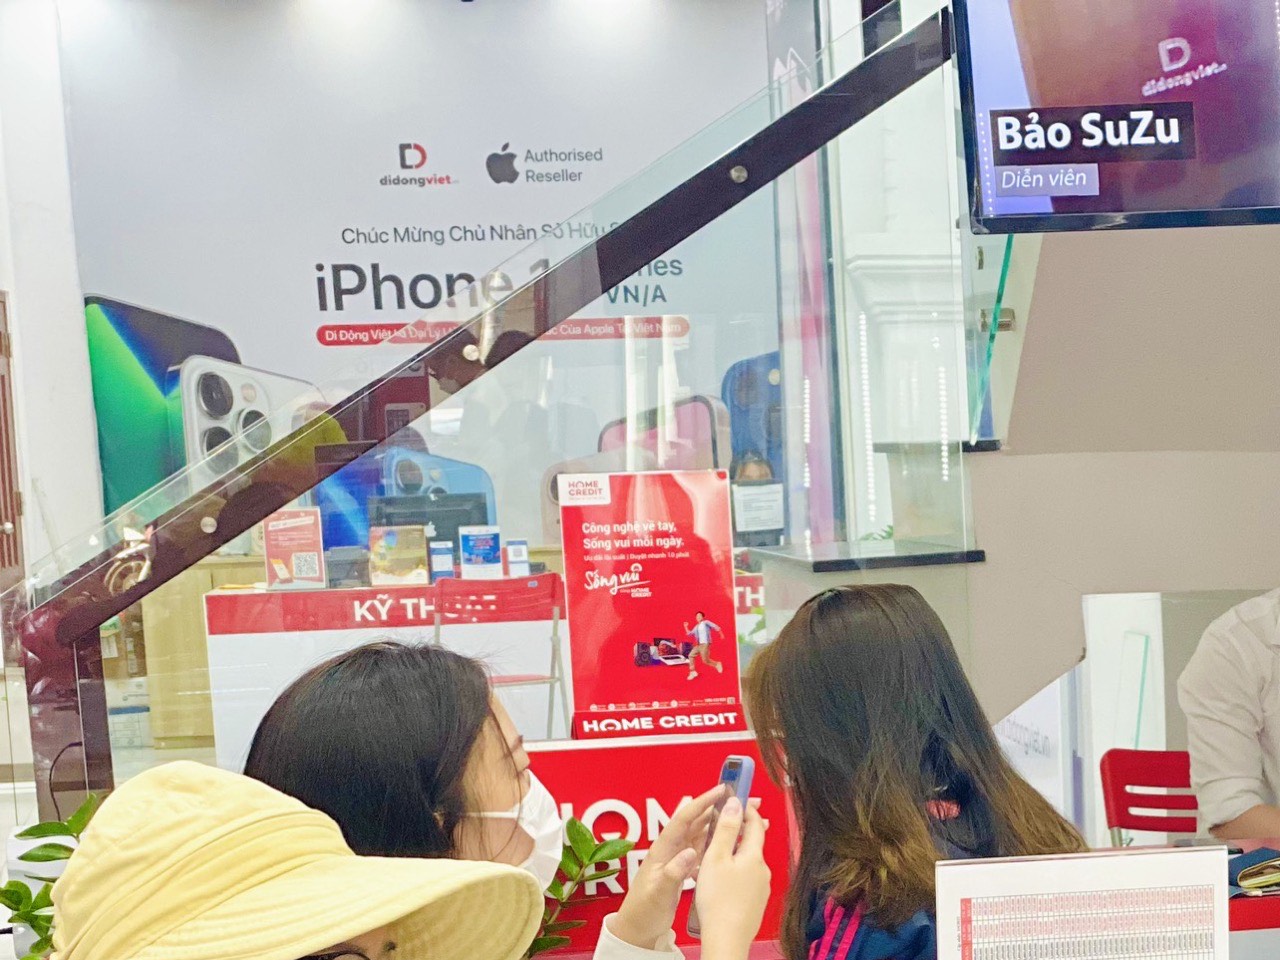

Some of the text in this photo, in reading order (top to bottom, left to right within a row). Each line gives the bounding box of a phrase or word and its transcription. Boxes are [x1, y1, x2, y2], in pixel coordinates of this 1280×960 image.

[998, 110, 1181, 150] Bảo SuZu
[524, 148, 603, 164] Authorised
[379, 174, 452, 188] didongviet
[525, 169, 583, 183] Reseller
[1001, 167, 1088, 189] Diễn viên
[342, 227, 389, 245] Chúc
[394, 226, 445, 246] Mừng
[449, 223, 486, 242] Chủ
[490, 224, 537, 241] Nhân
[315, 262, 513, 311] iPhone
[339, 329, 369, 343] Động
[567, 480, 599, 489] HOME
[568, 488, 604, 497] CREDIT
[582, 521, 611, 535] Công
[613, 521, 640, 535] nghệ
[583, 536, 612, 550] Sống
[614, 536, 630, 548] vui
[633, 535, 654, 548] mỗi
[584, 569, 618, 595] Sống
[354, 594, 393, 621] KỸ
[583, 711, 738, 733] HOME CREDIT
